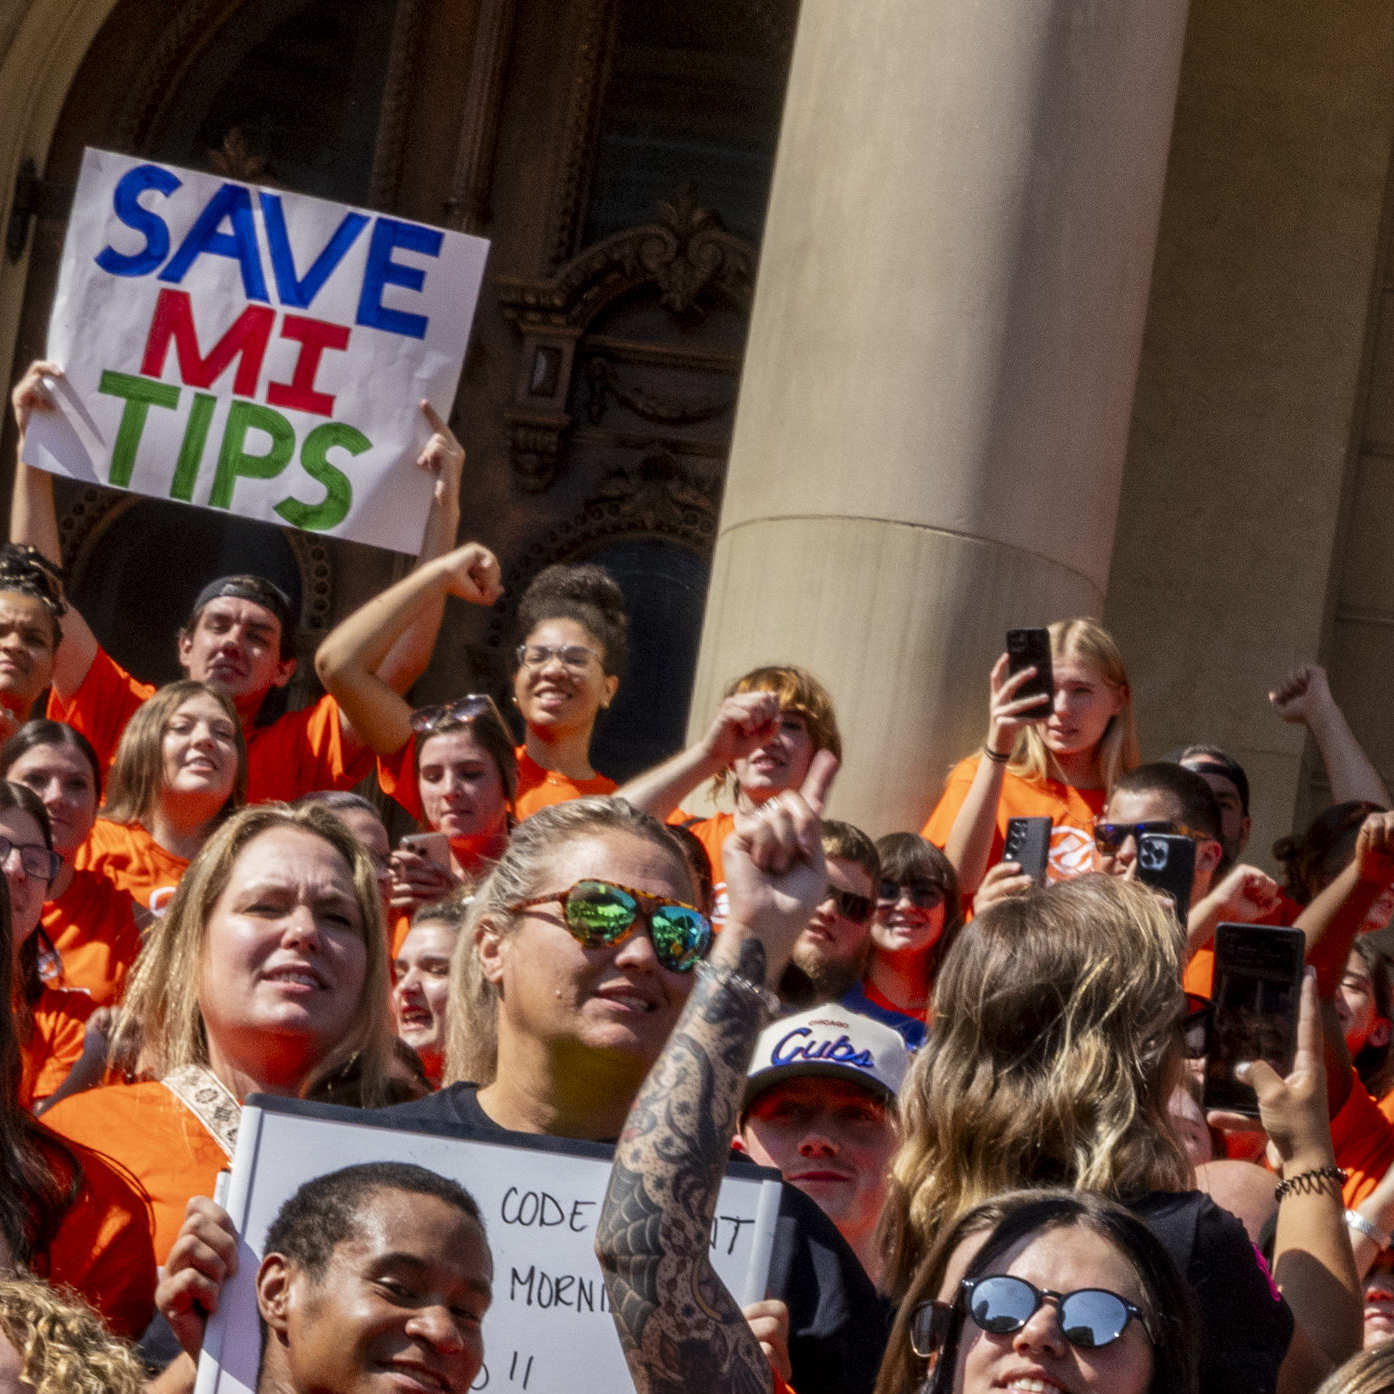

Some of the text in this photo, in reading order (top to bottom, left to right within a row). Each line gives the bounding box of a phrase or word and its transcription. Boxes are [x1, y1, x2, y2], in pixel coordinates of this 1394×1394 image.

[94, 164, 445, 340] SAVE
[140, 287, 352, 418] MI
[97, 369, 373, 531] TIPS
[771, 1027, 875, 1069] Cubs
[500, 1186, 597, 1233] CODE
